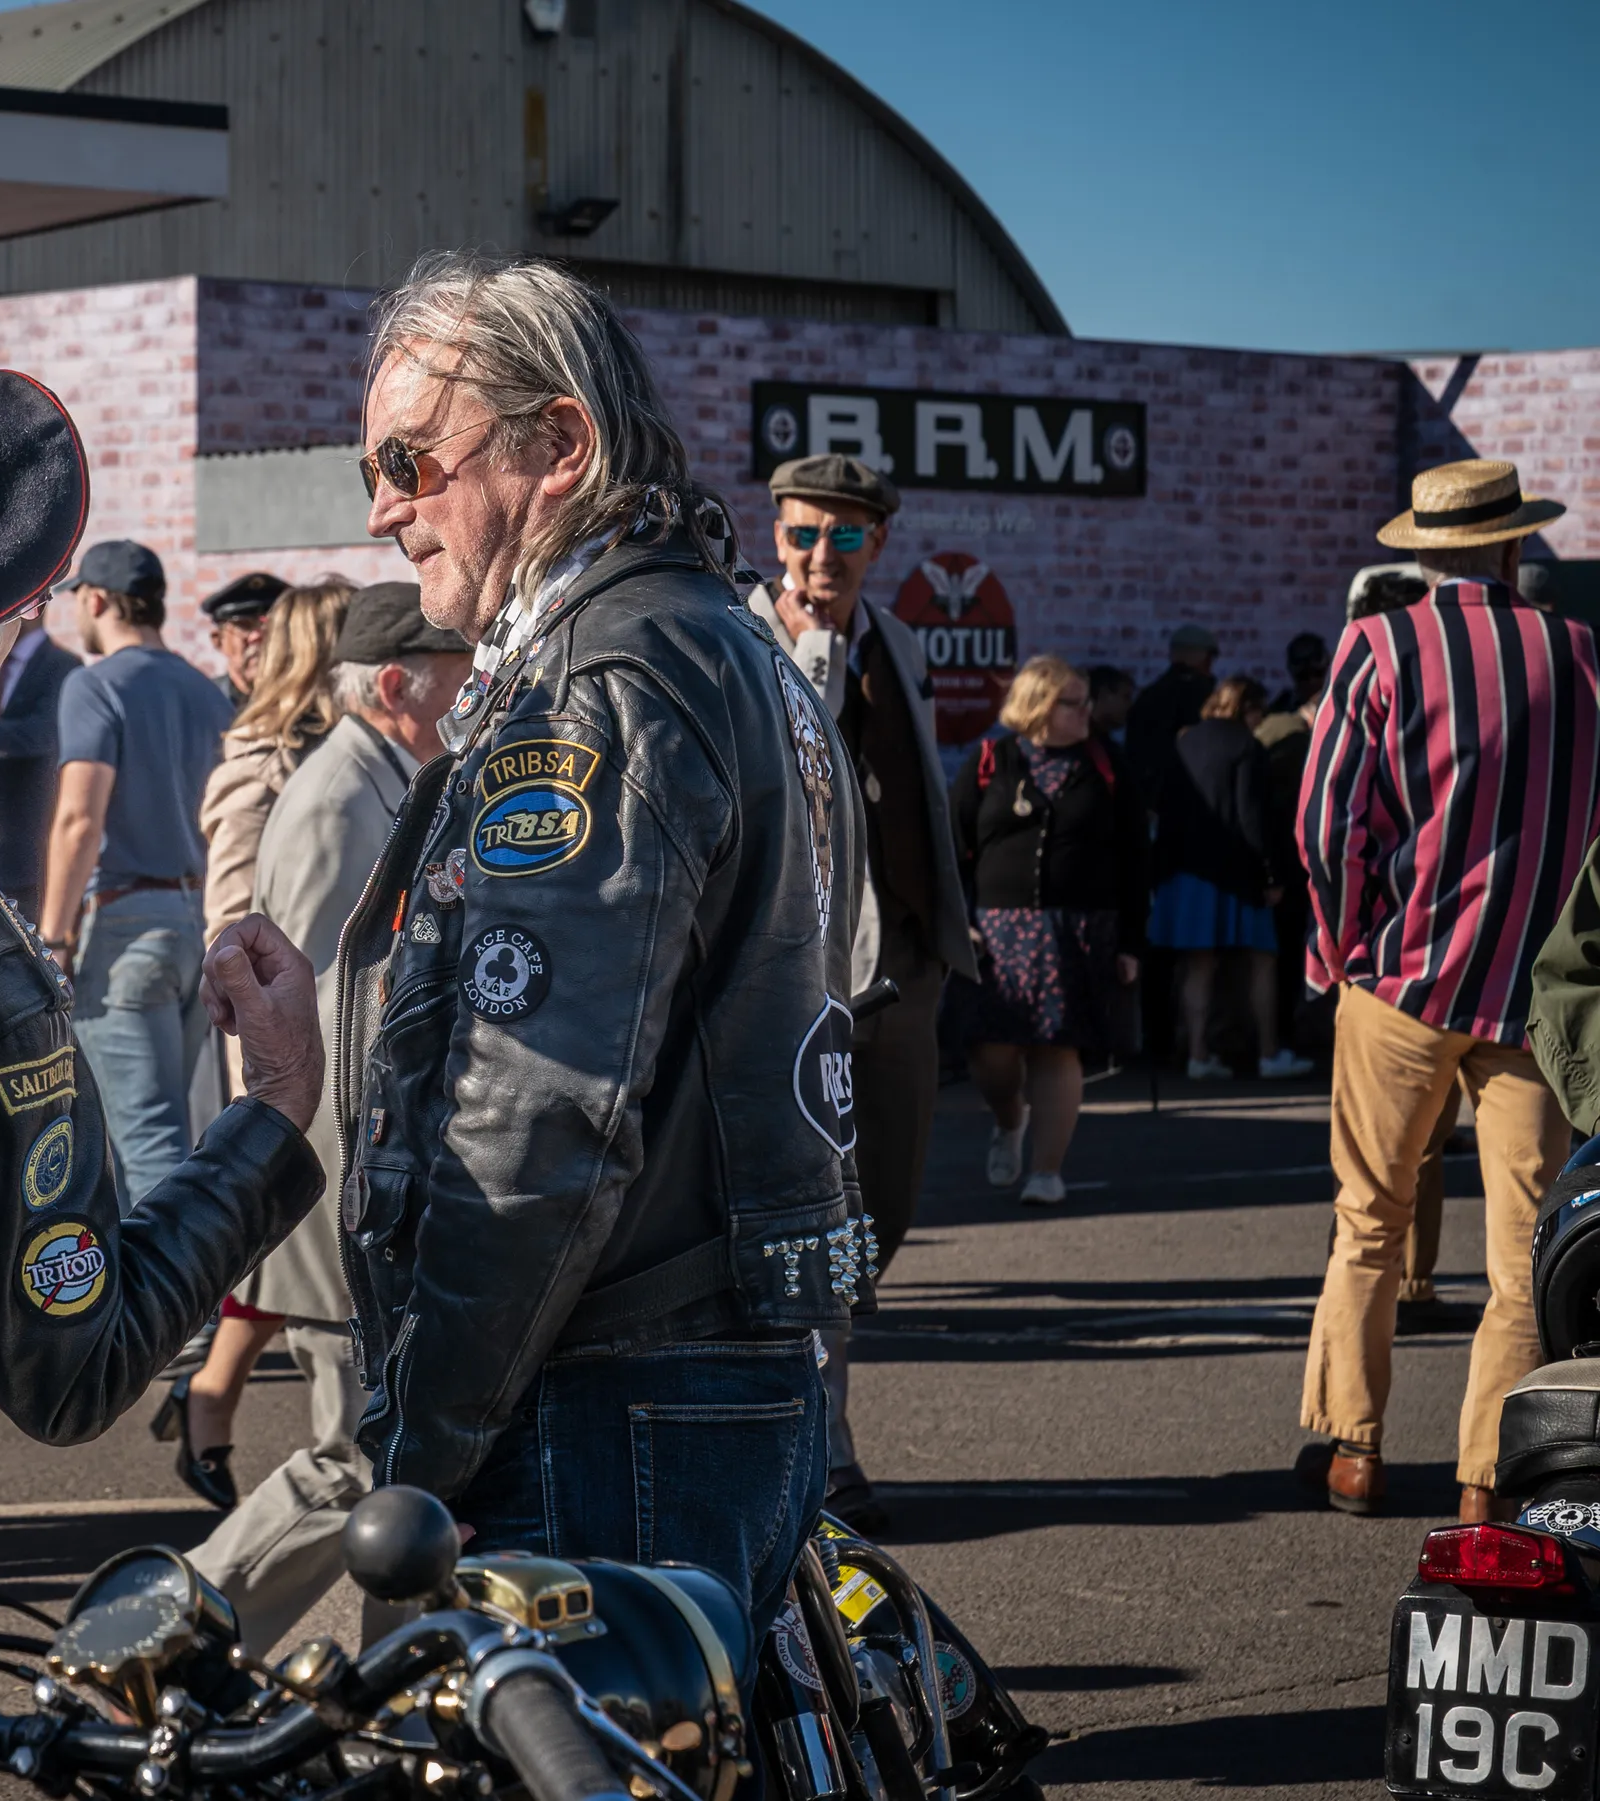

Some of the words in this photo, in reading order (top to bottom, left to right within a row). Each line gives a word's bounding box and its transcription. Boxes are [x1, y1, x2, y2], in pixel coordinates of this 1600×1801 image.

[489, 751, 575, 784] TRIBSA
[473, 929, 506, 957] ACE
[511, 933, 543, 975] CAFE
[463, 979, 528, 1015] LONDON
[480, 979, 513, 997] ACE
[30, 1124, 63, 1167] MOTORCYCLE
[1548, 1519, 1583, 1530] LONDON
[1575, 1505, 1591, 1518] CAFE
[777, 1636, 792, 1669] CORPS
[1406, 1611, 1590, 1701] MMD
[1415, 1702, 1560, 1791] 19C
